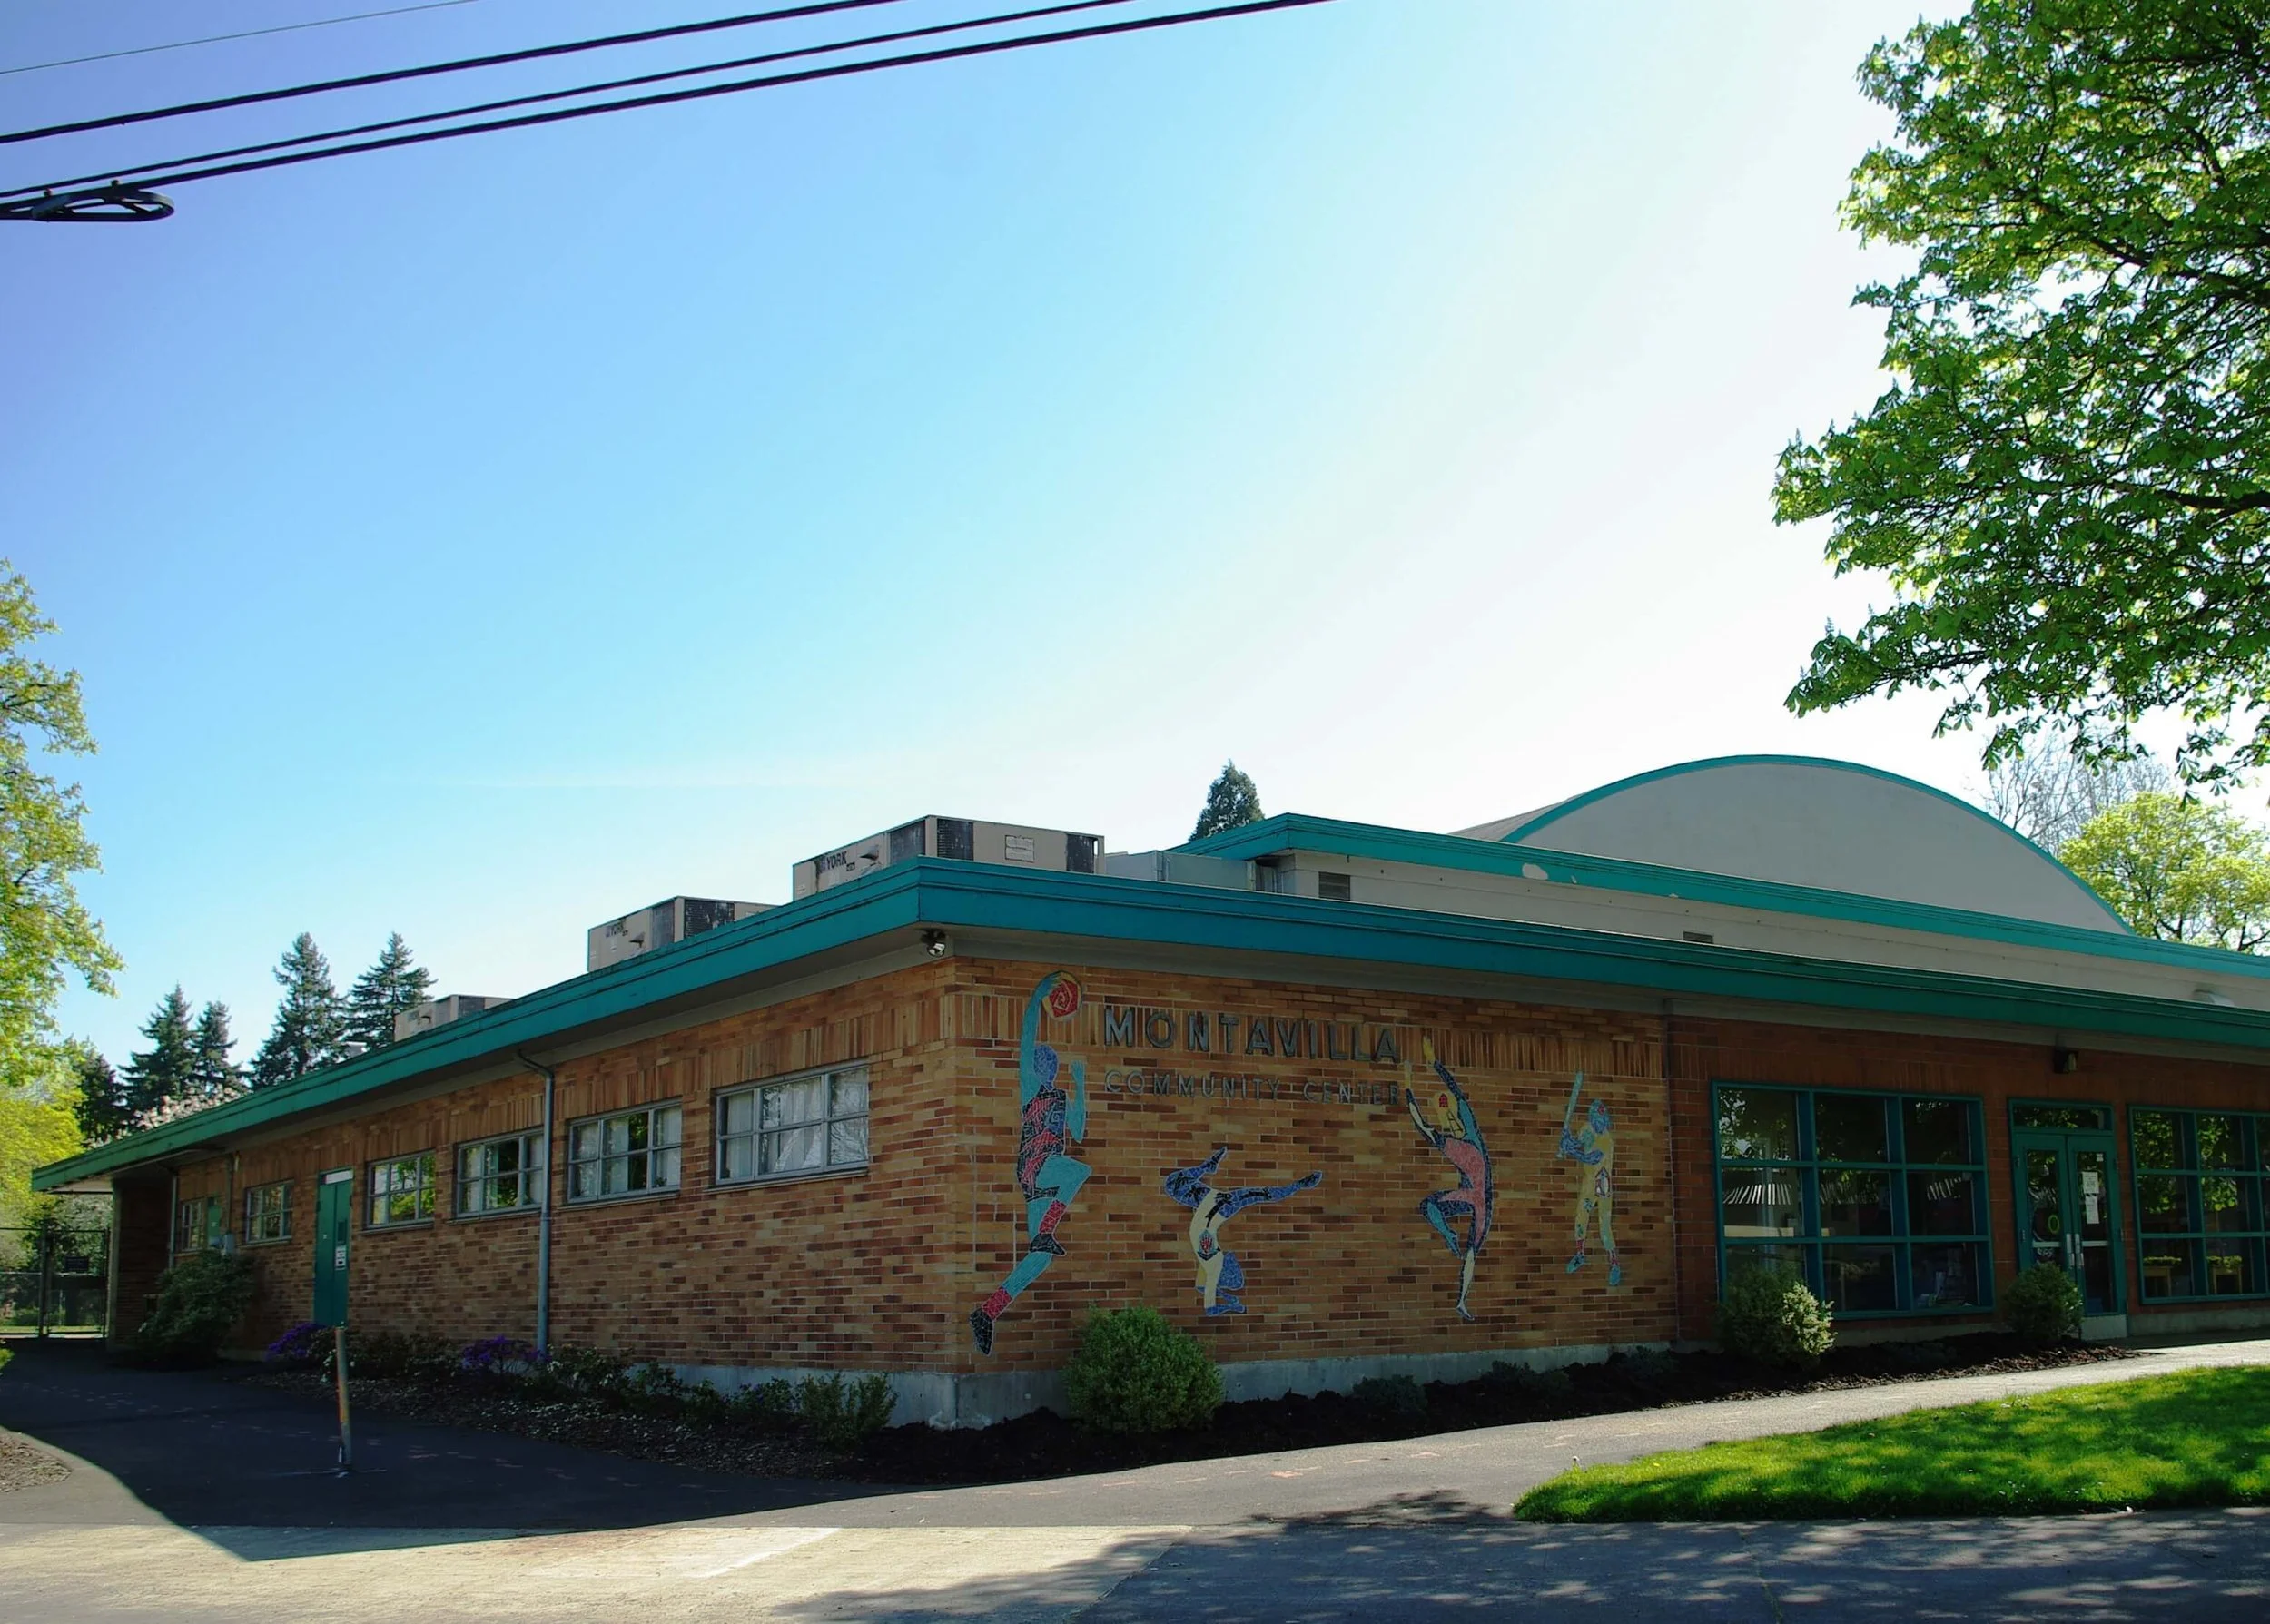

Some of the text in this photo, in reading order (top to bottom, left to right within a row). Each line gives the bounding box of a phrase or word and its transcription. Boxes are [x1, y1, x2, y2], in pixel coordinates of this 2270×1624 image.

[826, 851, 847, 870] YORK
[1105, 1008, 1399, 1063] MONTAVILLA
[1104, 1069, 1399, 1105] COMMUNITY CENTER
